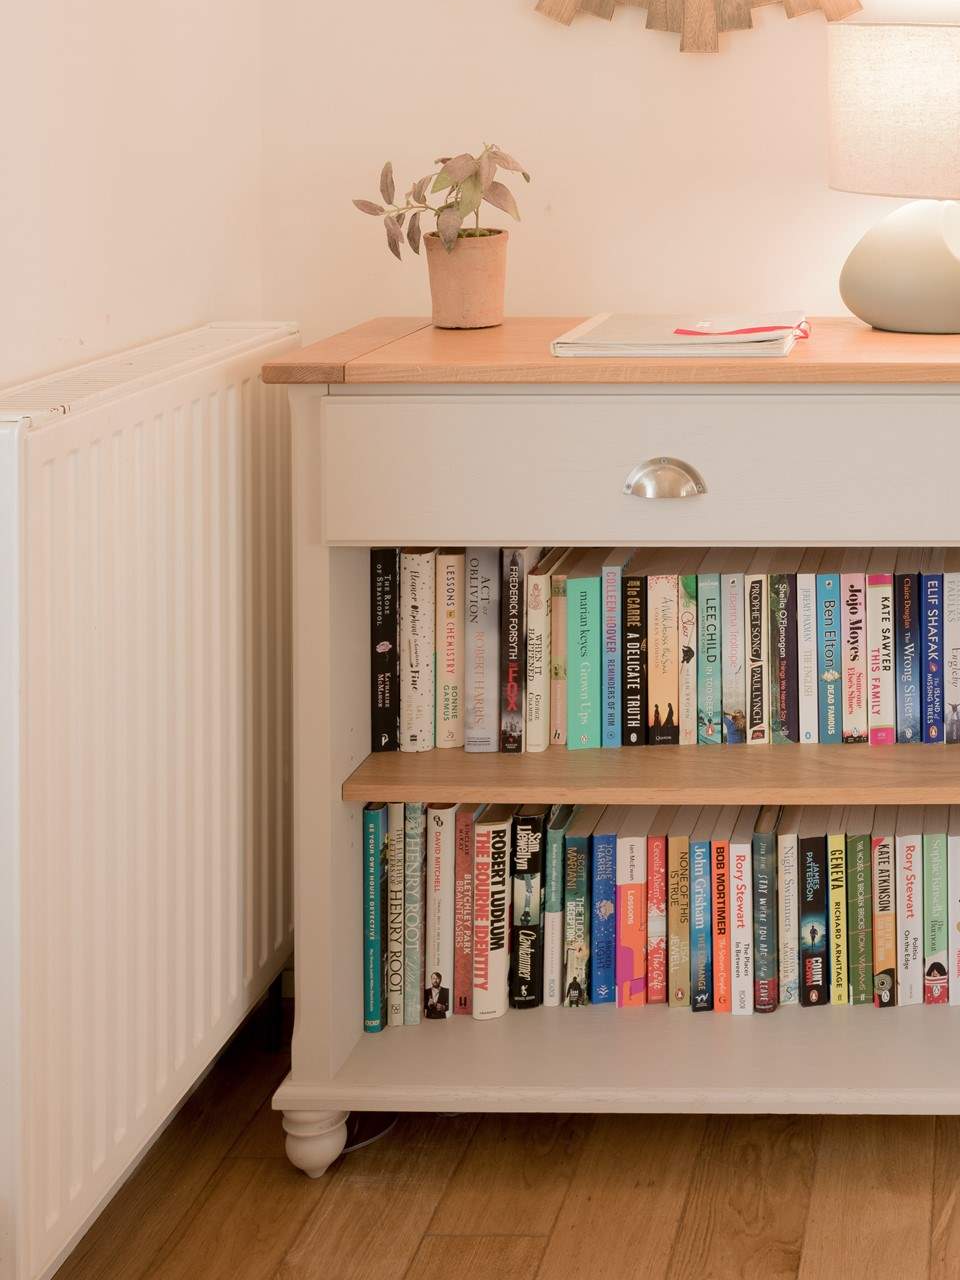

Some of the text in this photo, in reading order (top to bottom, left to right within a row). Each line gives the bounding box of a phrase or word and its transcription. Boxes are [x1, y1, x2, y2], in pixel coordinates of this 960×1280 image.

[410, 571, 420, 602] Eleanor
[469, 558, 479, 624] OBLIVION
[481, 576, 490, 604] ACT
[706, 598, 716, 619] LEE
[778, 584, 787, 608] Sheila
[903, 578, 912, 629] Claire Douglas
[446, 565, 455, 674] LESSONS CHEMISTRY
[509, 566, 518, 659] FREDERICK FORSYTH
[577, 591, 590, 657] marian keyes
[606, 572, 616, 653] COLLEEN HOOVER
[751, 583, 760, 654] PROPHET SONG
[824, 600, 837, 667] Ben Elton
[846, 585, 862, 662] Jojo Moyes
[881, 597, 891, 671] KATE SAWYER
[928, 581, 938, 660] ELIF SHAFAK
[627, 642, 640, 689] DELICATE
[706, 624, 717, 663] CHILD
[411, 670, 419, 690] Fine
[474, 631, 485, 724] ROBERT HARRIS
[535, 666, 542, 675] IT
[607, 659, 616, 726] REMINDERS OF HIM
[871, 648, 881, 716] THIS FAMILY
[902, 643, 915, 718] Wrong Sister
[627, 695, 640, 727] TRUTH
[753, 668, 761, 723] PAUL LYNCH
[827, 706, 835, 735] FAMOUS
[514, 825, 531, 870] Llewellyn
[529, 833, 541, 852] Sam
[597, 844, 605, 880] HARRIS
[605, 843, 613, 879] JOANNE
[878, 844, 890, 866] KATE
[406, 838, 419, 899] HENRY
[490, 829, 506, 951] ROBERT LUDLUM
[567, 847, 577, 889] MARIANI
[577, 854, 585, 881] SCOTT
[653, 873, 662, 898] Ahern
[670, 870, 679, 907] IS TRUE
[680, 852, 688, 923] NONE OF THIS
[694, 846, 706, 929] John Grisham
[759, 874, 768, 894] STAY
[782, 846, 795, 933] Night Swimmers
[812, 863, 820, 890] JAMES
[830, 849, 843, 890] GENEVA
[878, 869, 890, 912] ATKINSON
[903, 845, 916, 919] Rory Stewart
[456, 880, 464, 947] BRAINTEASERS
[474, 831, 490, 990] THE BOURNE IDENTITY
[627, 890, 635, 924] Lessons
[716, 847, 726, 935] BOB MORTIMER
[734, 855, 746, 929] Rory Stewart
[759, 898, 768, 922] WHERE
[389, 890, 402, 995] HENRY ROOT
[406, 903, 419, 952] ROOT
[463, 931, 471, 954] PARK
[567, 901, 575, 941] DECEPTION
[576, 897, 584, 946] THE TUDOR
[834, 902, 842, 940] RICHARD
[904, 930, 910, 941] On
[518, 930, 536, 981] Clawhammer
[671, 935, 679, 972] JEWELL
[812, 957, 822, 986] COUNT
[760, 981, 768, 1001] LEAVE
